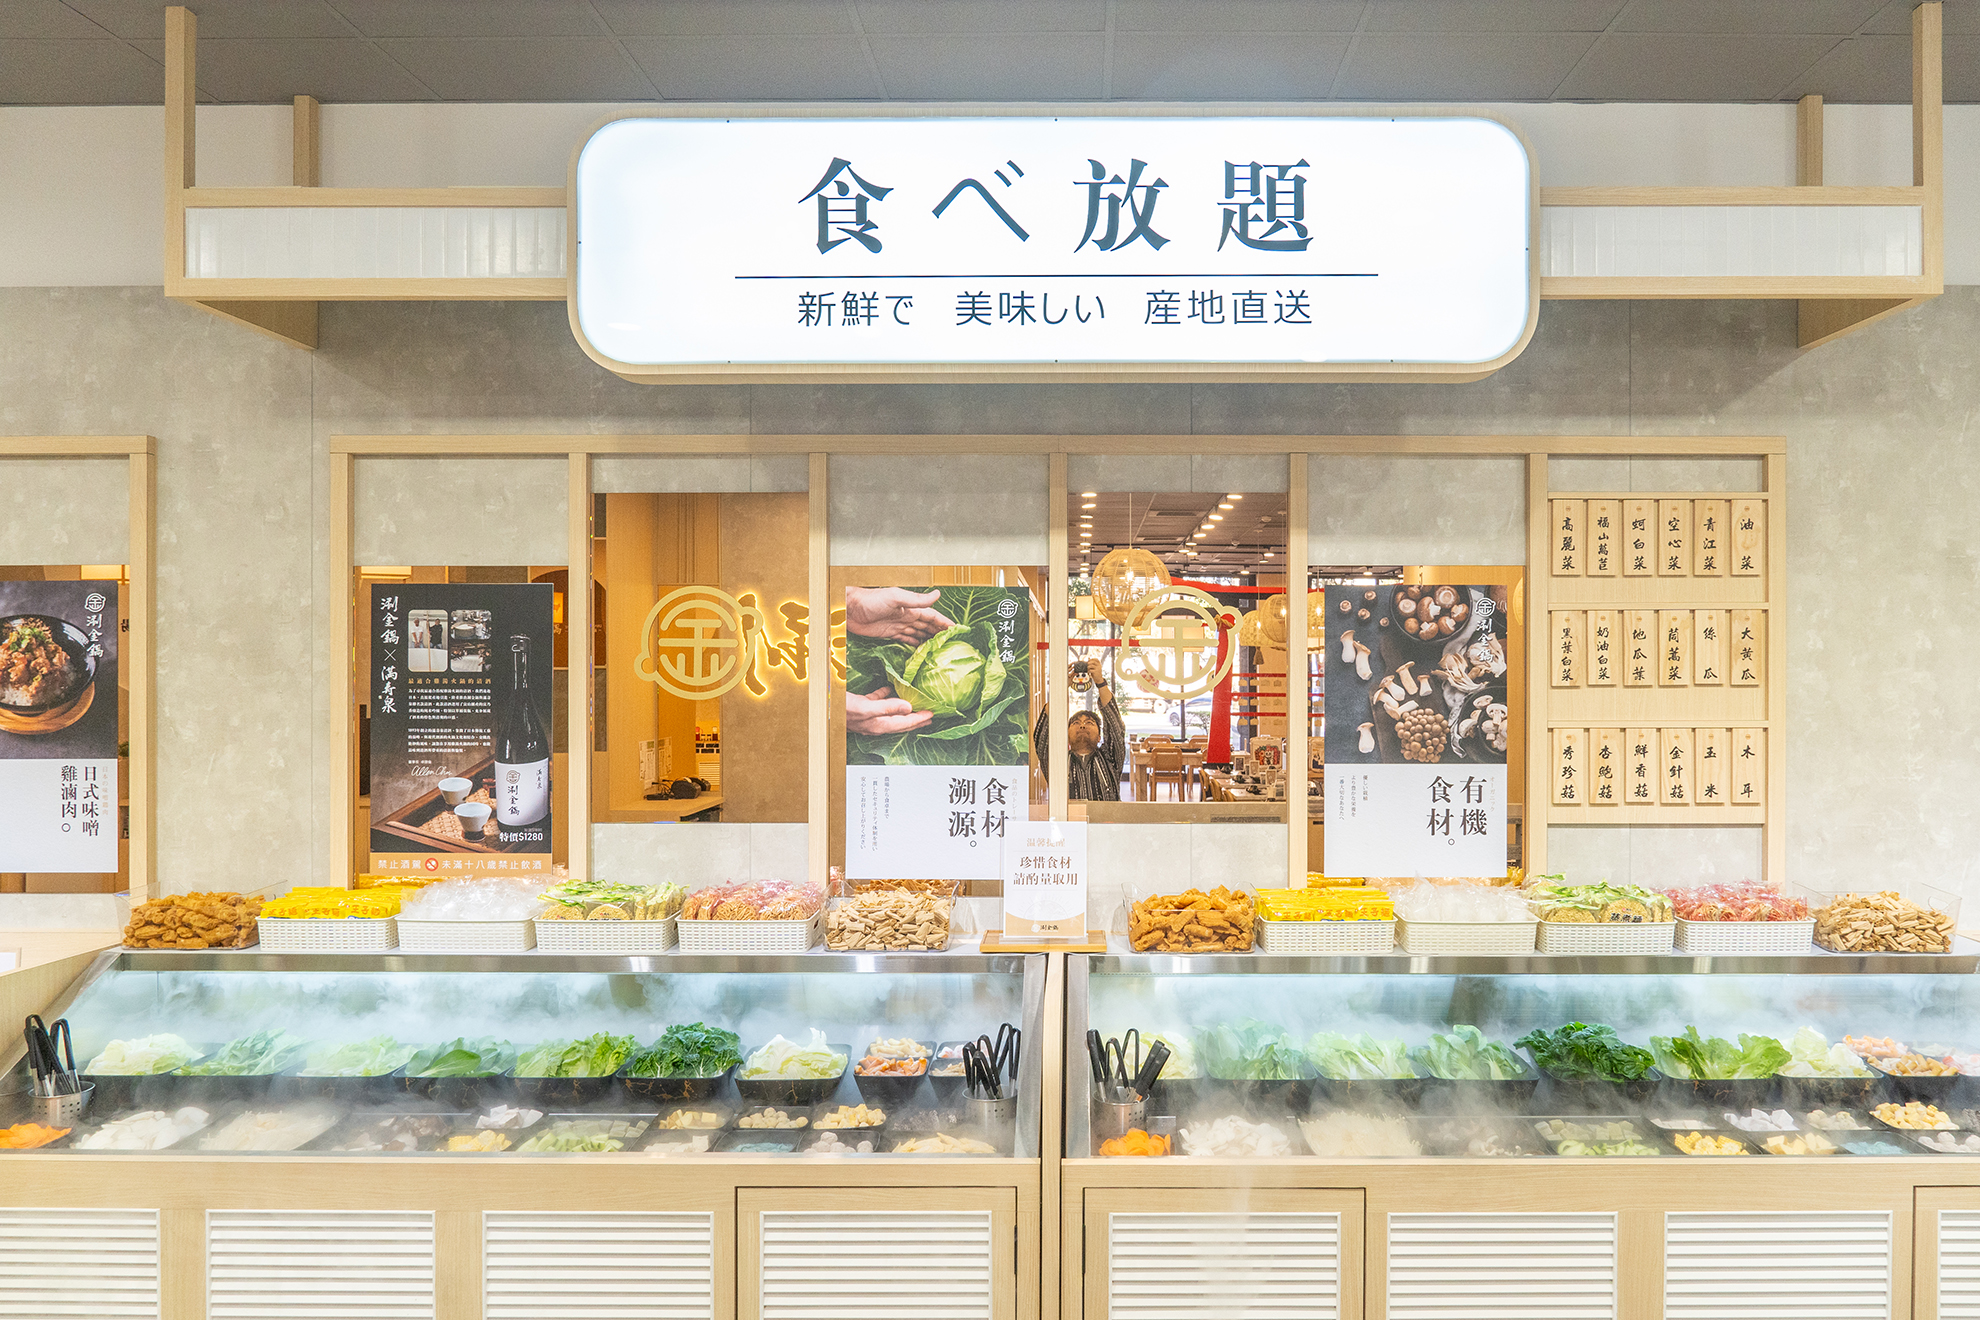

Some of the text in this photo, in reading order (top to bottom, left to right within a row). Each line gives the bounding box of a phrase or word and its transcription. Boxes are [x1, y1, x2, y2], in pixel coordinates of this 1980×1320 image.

[798, 157, 1313, 255] 食べ放題
[798, 290, 1312, 327] 新鮮で 美味しい 産地直送
[1560, 516, 1576, 571] 高麗菜
[1667, 516, 1683, 571] 空心菜
[1703, 516, 1717, 571] 青江菜
[86, 613, 104, 658] 涮金鍋
[998, 619, 1016, 664] 涮金鍋
[1596, 626, 1611, 681] 奶油白菜
[1632, 628, 1648, 681] 地瓜葉
[1667, 627, 1682, 681] 茼蒿菜
[1739, 626, 1756, 681] 大黃瓜
[1560, 745, 1577, 800] 秀珍菇
[1597, 744, 1614, 800] 杏鮑菇
[1633, 743, 1649, 798] 鮮香菇
[1669, 745, 1684, 799] 金針菇
[82, 766, 100, 837] 日式味噌
[981, 777, 1010, 838] 食材
[1459, 775, 1488, 836] 有機
[377, 859, 542, 870] 禁止酒駕 未滿十八歲禁止飲酒
[499, 831, 544, 843] 特價$1280
[1019, 855, 1072, 869] 珍惜食材
[1013, 872, 1078, 886] 請酌量取用
